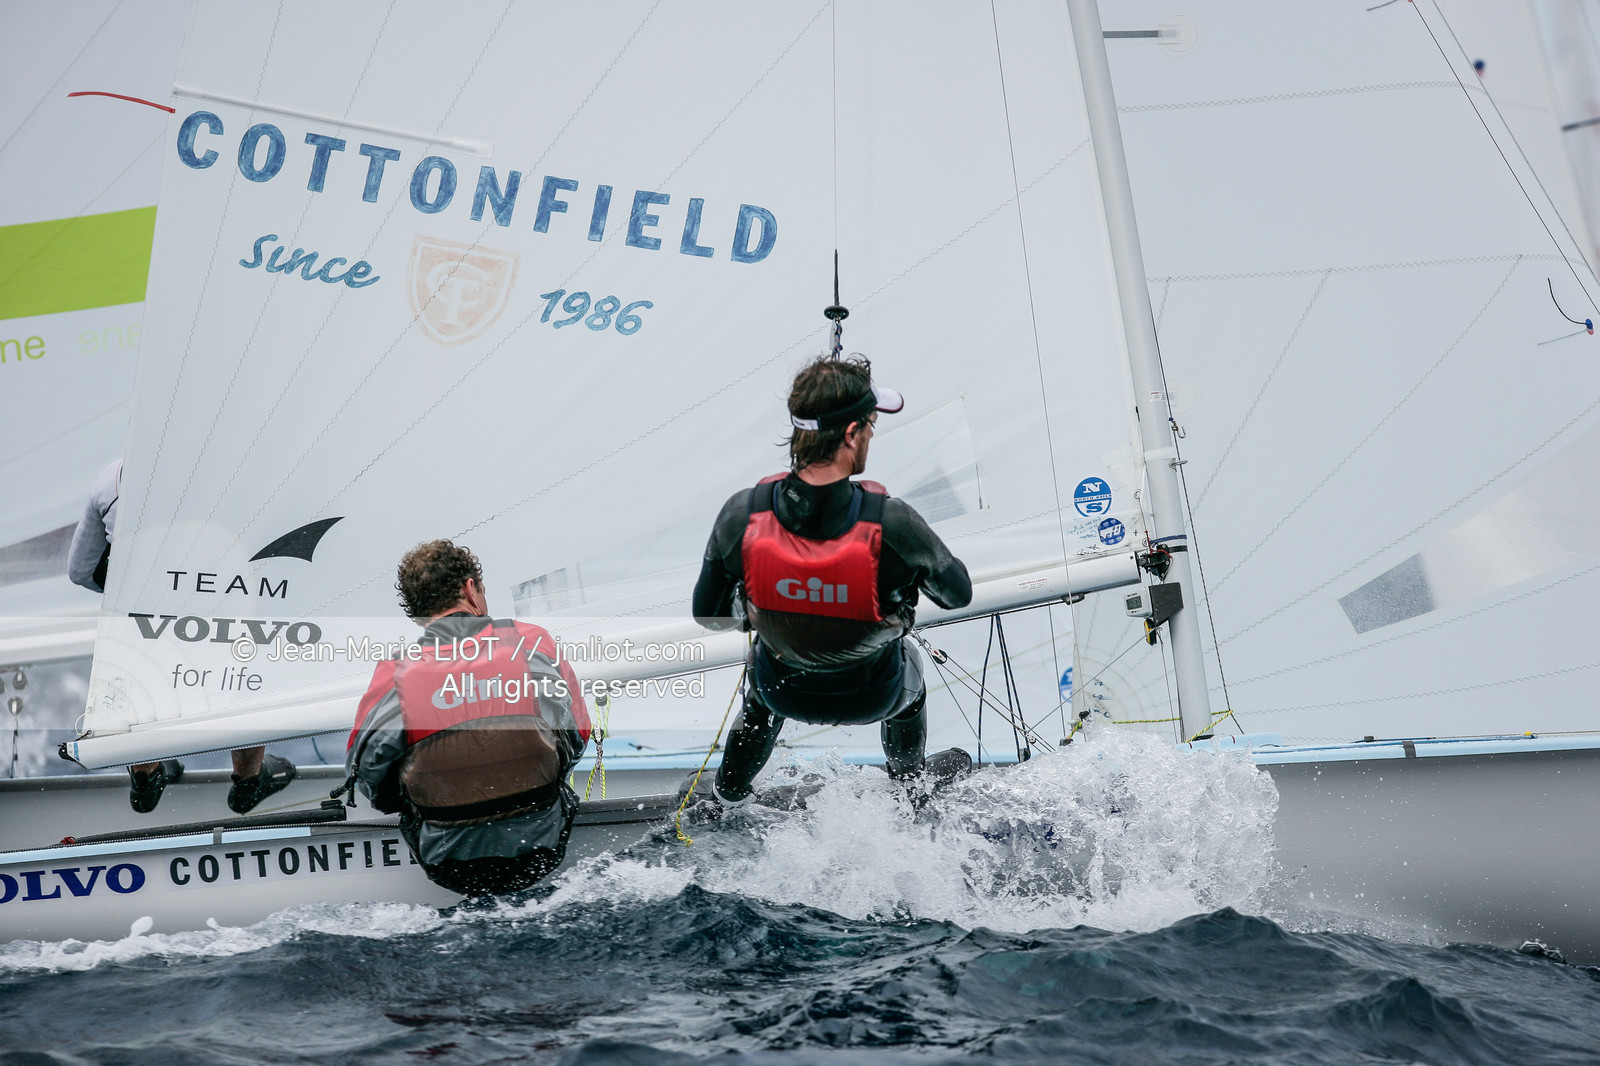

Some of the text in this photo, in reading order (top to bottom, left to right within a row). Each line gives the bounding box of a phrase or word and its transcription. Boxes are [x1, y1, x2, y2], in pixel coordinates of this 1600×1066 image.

[176, 110, 778, 264] COTTONFIELD
[539, 289, 653, 335] 1986
[167, 570, 289, 599] TEAM
[776, 577, 848, 603] Gill
[128, 613, 322, 646] VOLVO
[172, 664, 263, 691] for life
